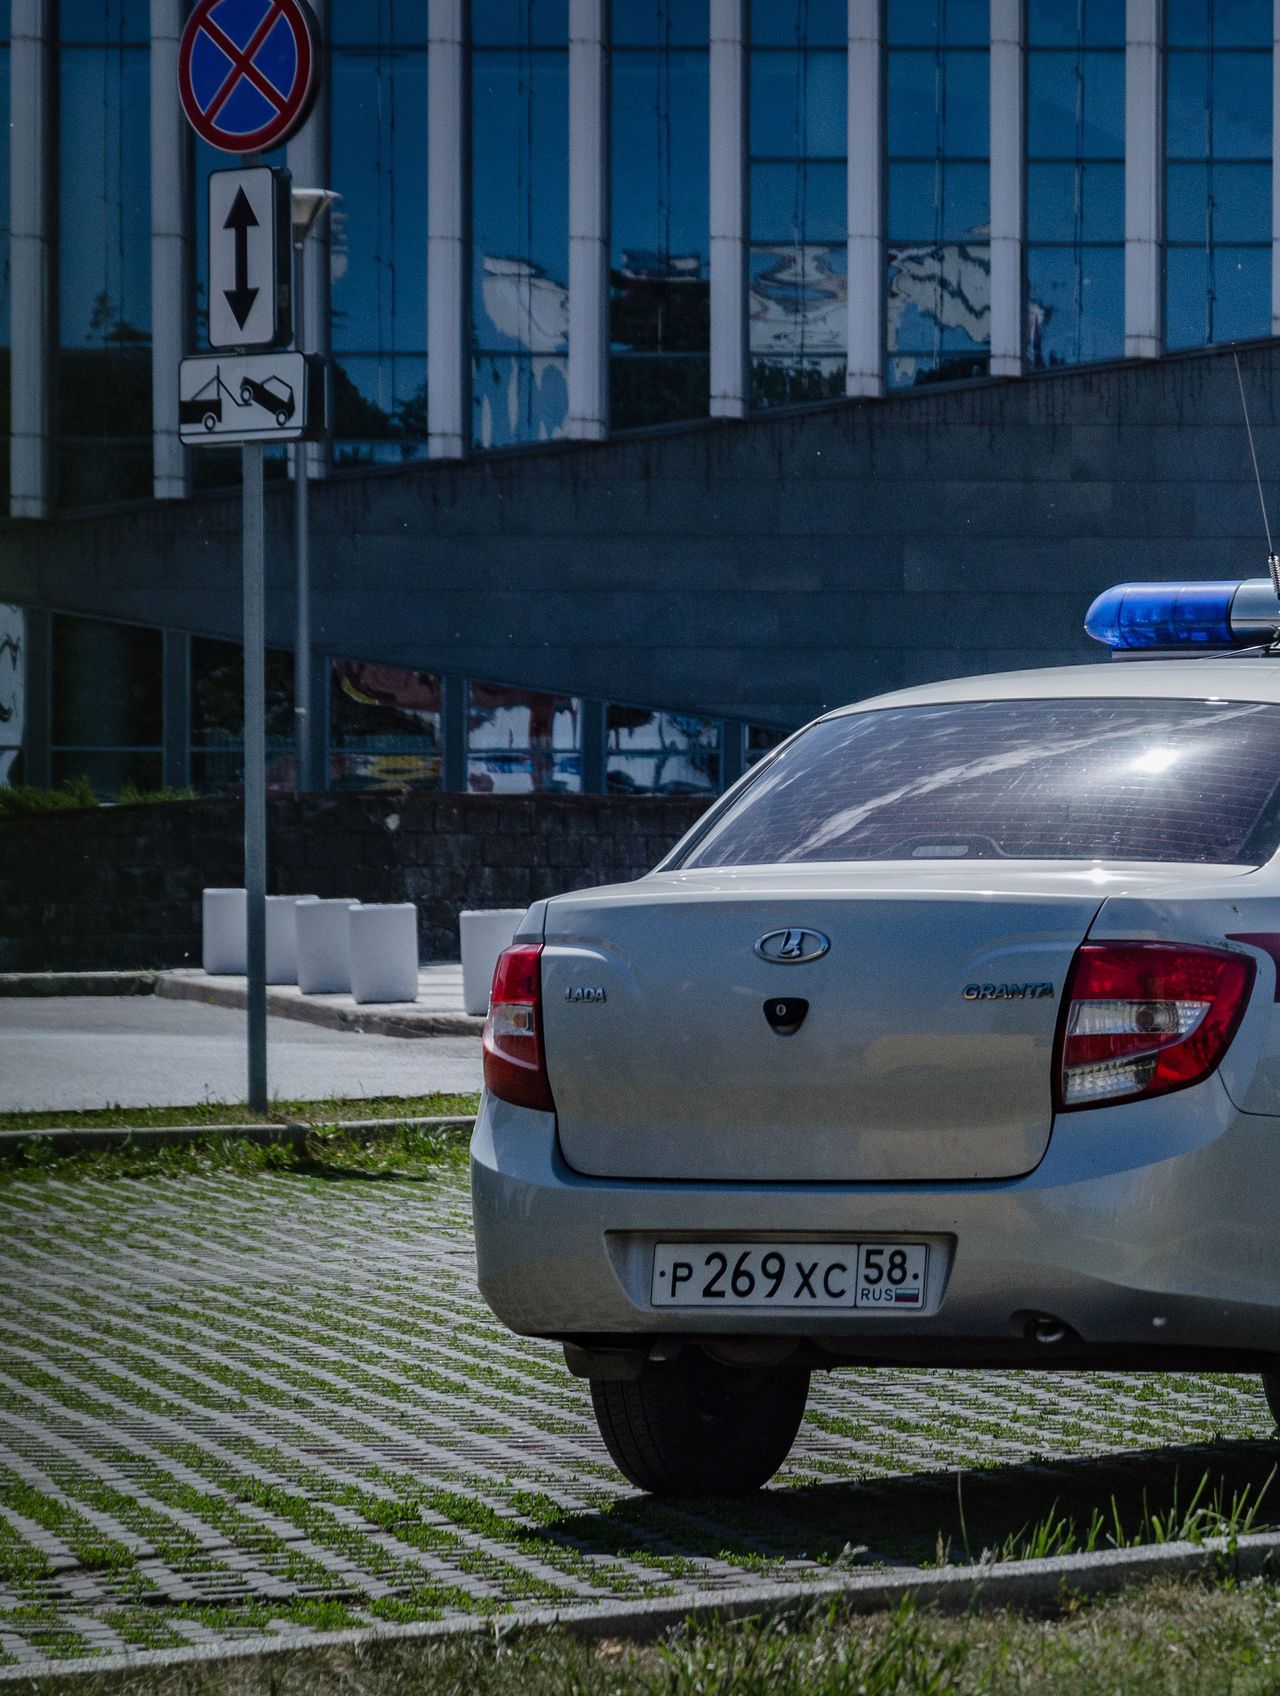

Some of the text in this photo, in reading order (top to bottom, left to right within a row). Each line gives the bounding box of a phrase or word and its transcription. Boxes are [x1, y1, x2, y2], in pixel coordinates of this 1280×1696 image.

[565, 986, 606, 1003] LADA
[962, 982, 1055, 1001] GRANTA
[863, 1248, 908, 1285] 58
[861, 1287, 894, 1302] RUS
